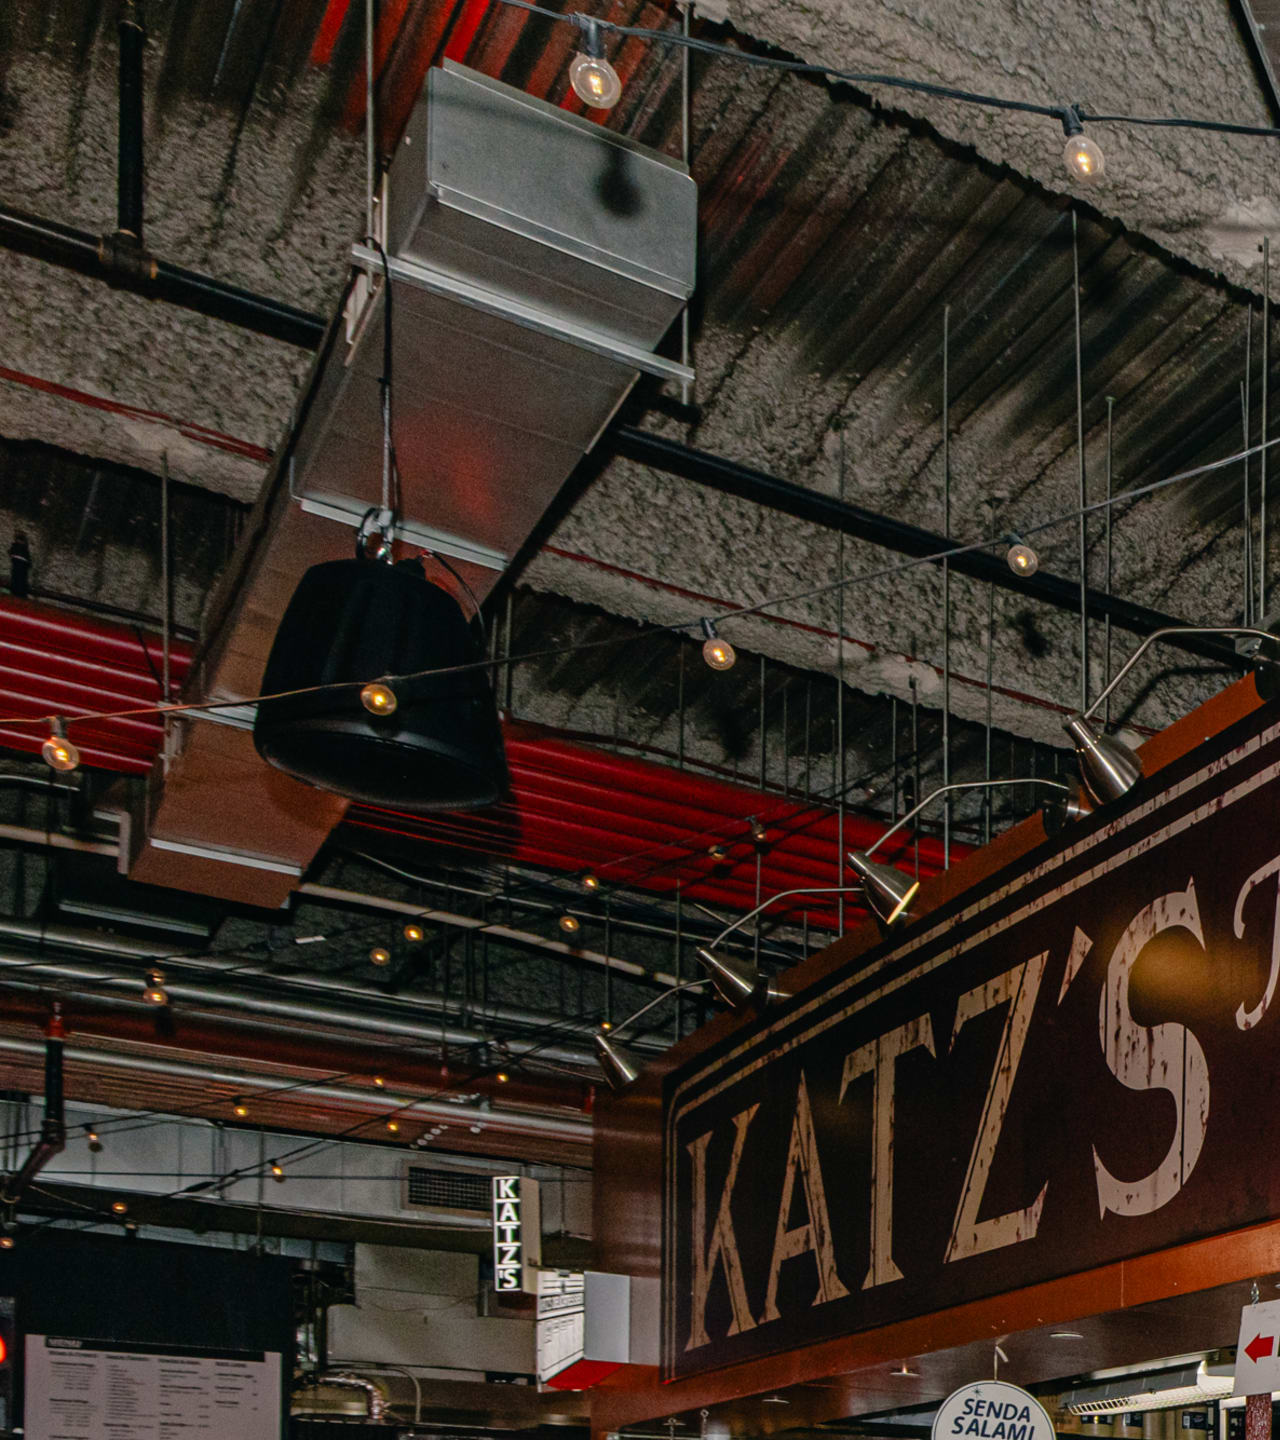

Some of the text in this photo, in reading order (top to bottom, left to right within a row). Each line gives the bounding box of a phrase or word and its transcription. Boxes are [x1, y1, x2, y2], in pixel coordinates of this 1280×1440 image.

[685, 876, 1210, 1352] KATZ'S
[499, 1179, 518, 1288] KATZ'S
[963, 1398, 1030, 1423] SENDA
